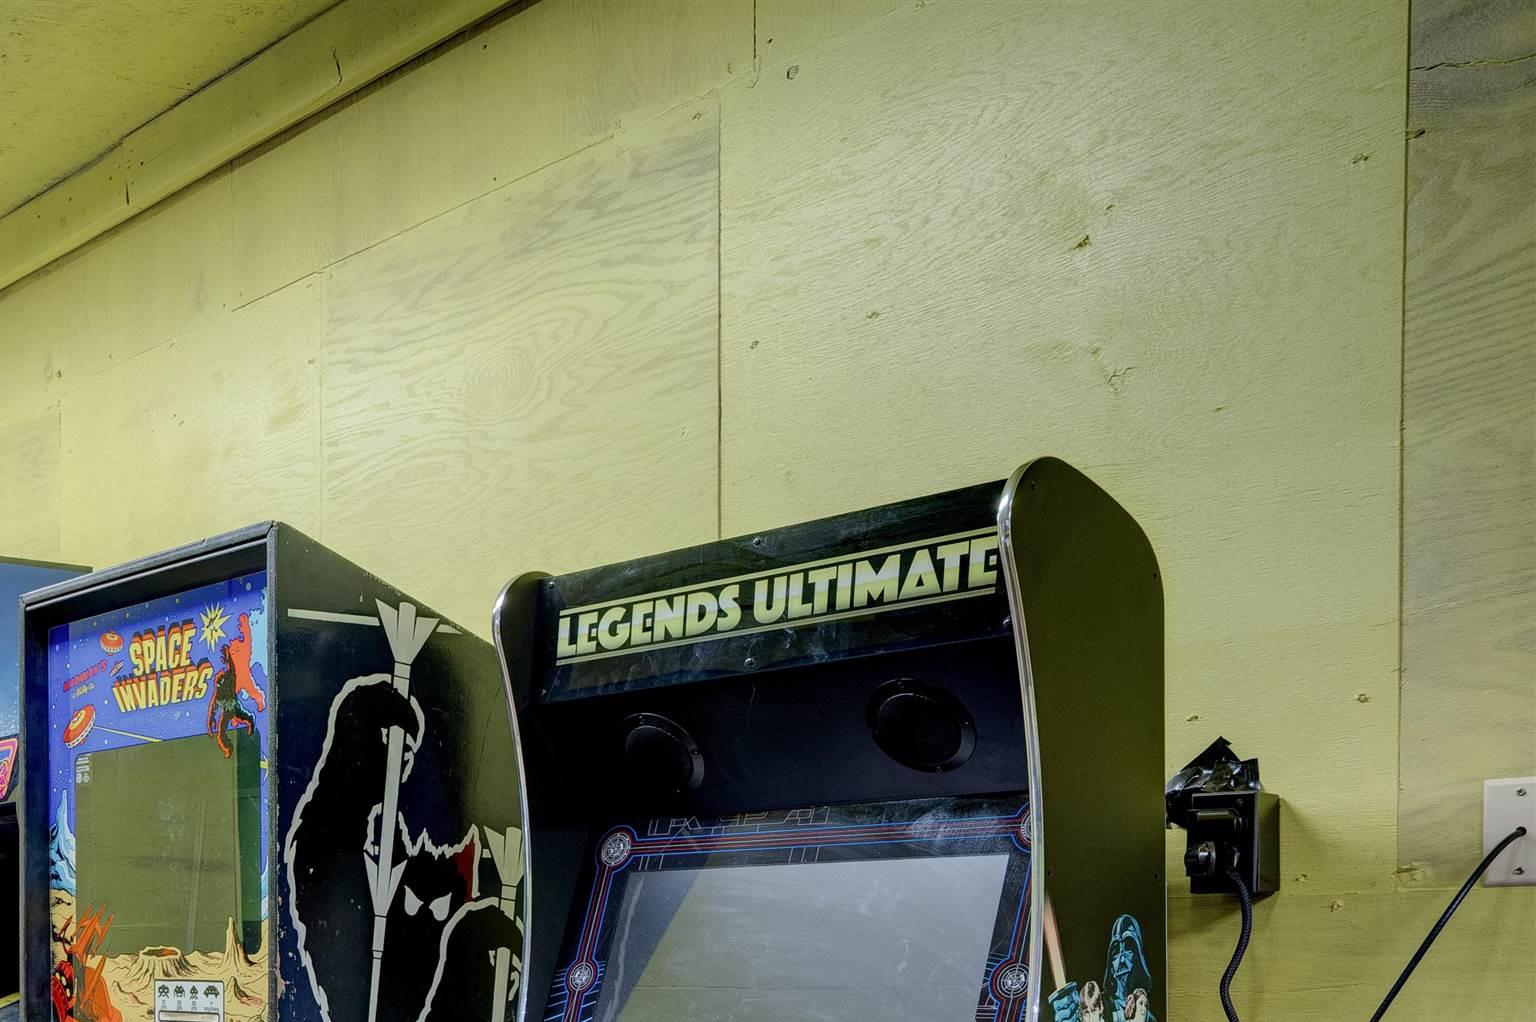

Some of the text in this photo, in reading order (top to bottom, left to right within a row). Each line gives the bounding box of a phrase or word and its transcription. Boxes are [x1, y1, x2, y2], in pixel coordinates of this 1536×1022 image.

[557, 535, 999, 659] LEGENDS ULTIMATE
[129, 621, 197, 677] SPACE
[112, 660, 214, 713] INVADERS
